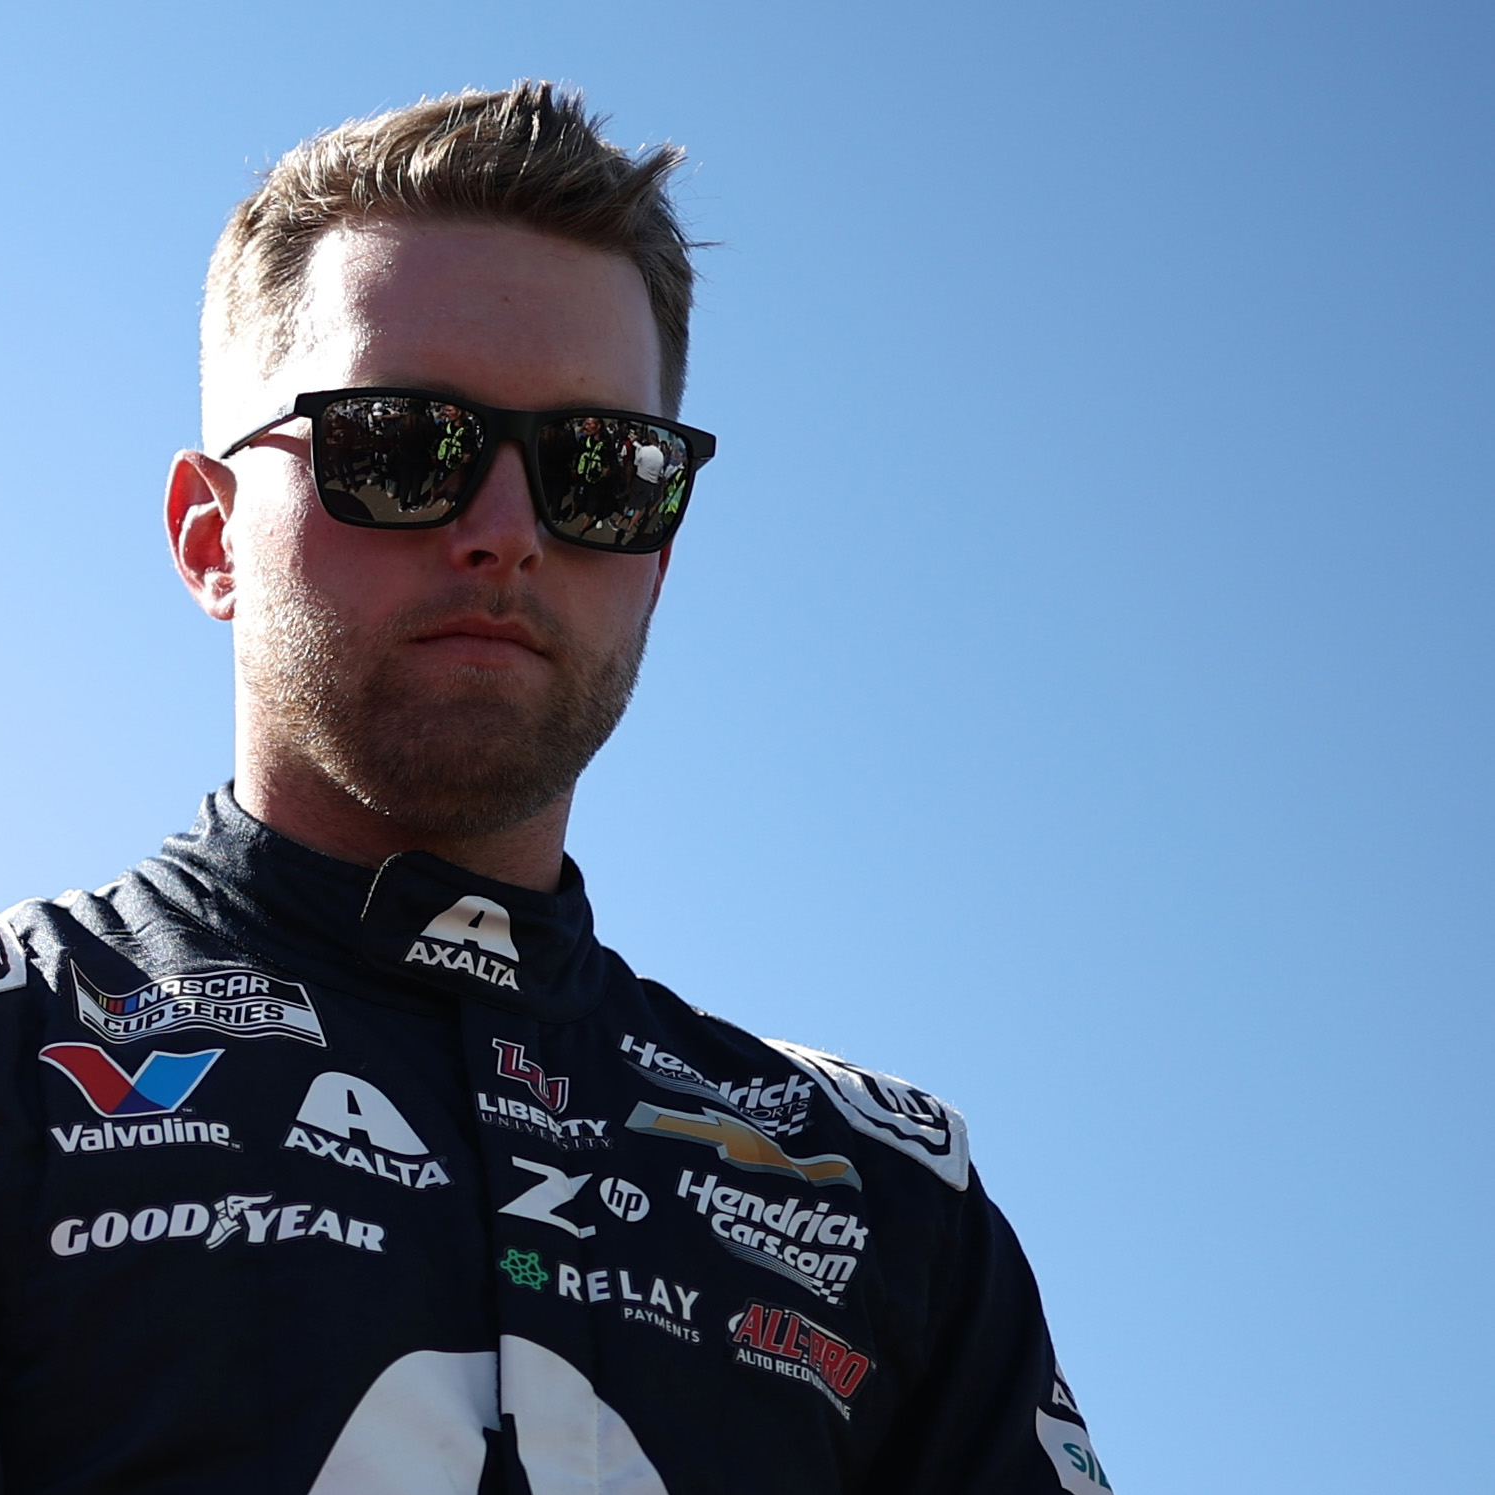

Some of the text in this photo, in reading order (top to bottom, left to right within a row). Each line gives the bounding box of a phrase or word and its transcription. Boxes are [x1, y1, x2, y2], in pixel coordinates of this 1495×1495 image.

[404, 941, 520, 992] AXALTA
[138, 976, 270, 1006] NASCAR
[104, 999, 285, 1034] CUP SERIES
[51, 1117, 231, 1154] Valvoline
[477, 1092, 608, 1139] LIBERTY
[481, 1112, 611, 1150] UNIVERSITY
[283, 1127, 453, 1190] AXALTA
[677, 1170, 869, 1252] Hendrick
[711, 1213, 858, 1284] Cars.com
[558, 1262, 700, 1321] RELAY
[624, 1306, 701, 1346] PAYMENTS
[732, 1303, 869, 1398] ALL-PRO
[736, 1348, 773, 1371] AUTO
